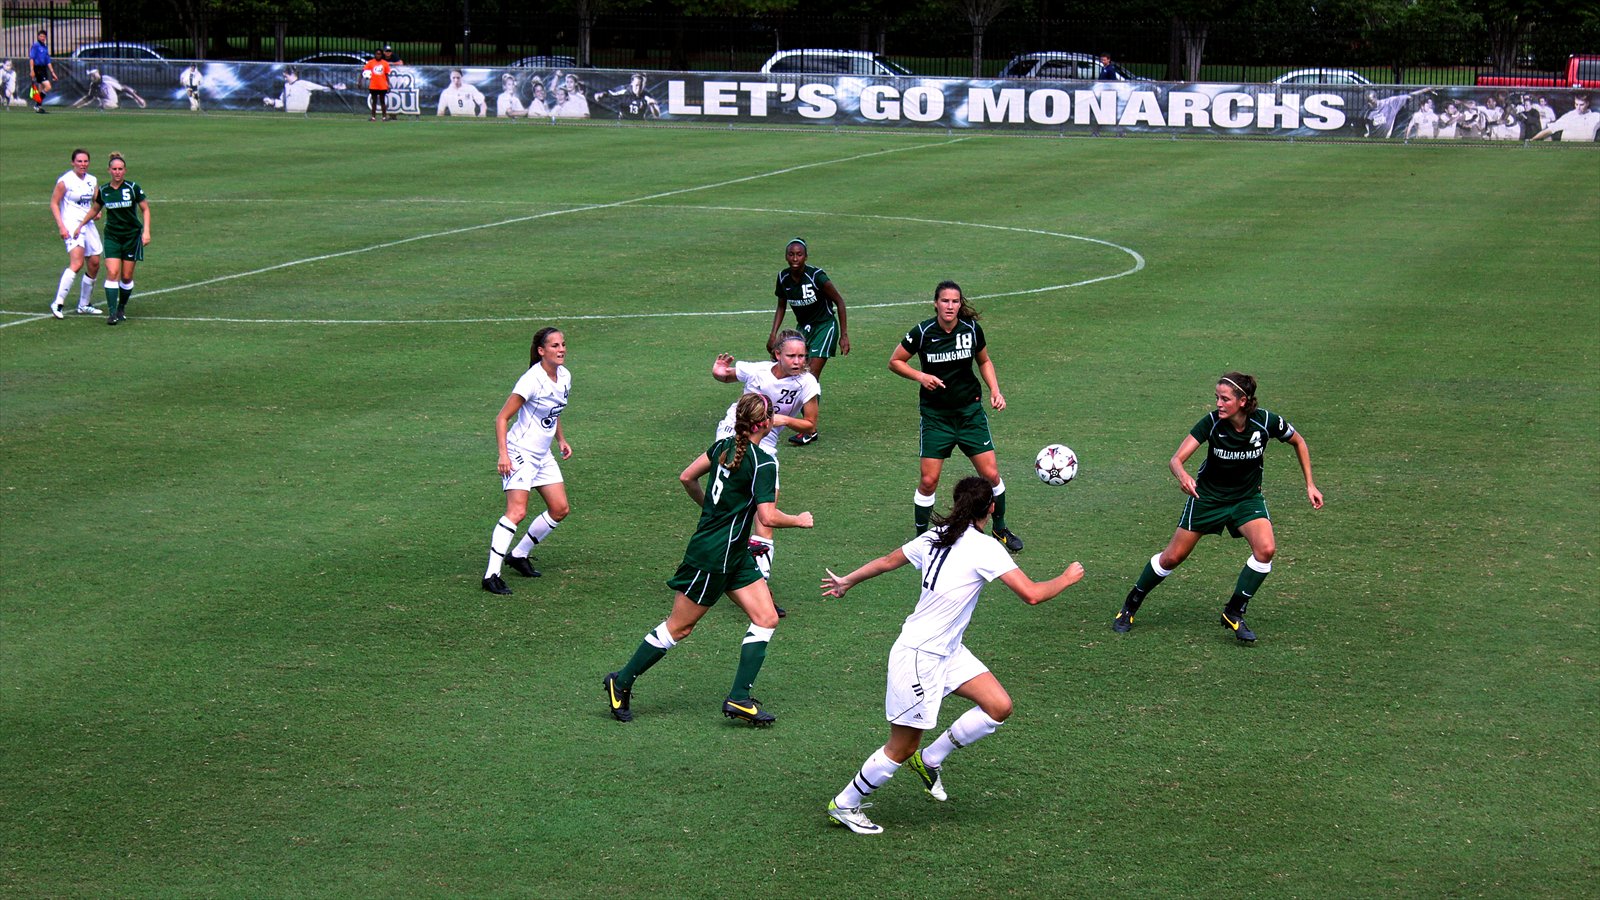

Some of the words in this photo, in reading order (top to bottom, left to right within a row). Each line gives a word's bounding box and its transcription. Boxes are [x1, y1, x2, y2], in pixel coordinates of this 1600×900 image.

[629, 104, 639, 115] 13
[859, 84, 945, 122] GO
[967, 87, 1346, 130] MONARCHS
[122, 188, 131, 201] 5
[801, 284, 816, 299] 15
[955, 332, 973, 350] 18
[776, 388, 798, 404] 23
[1249, 430, 1262, 448] 4
[711, 464, 731, 505] 6
[922, 542, 952, 591] 21
